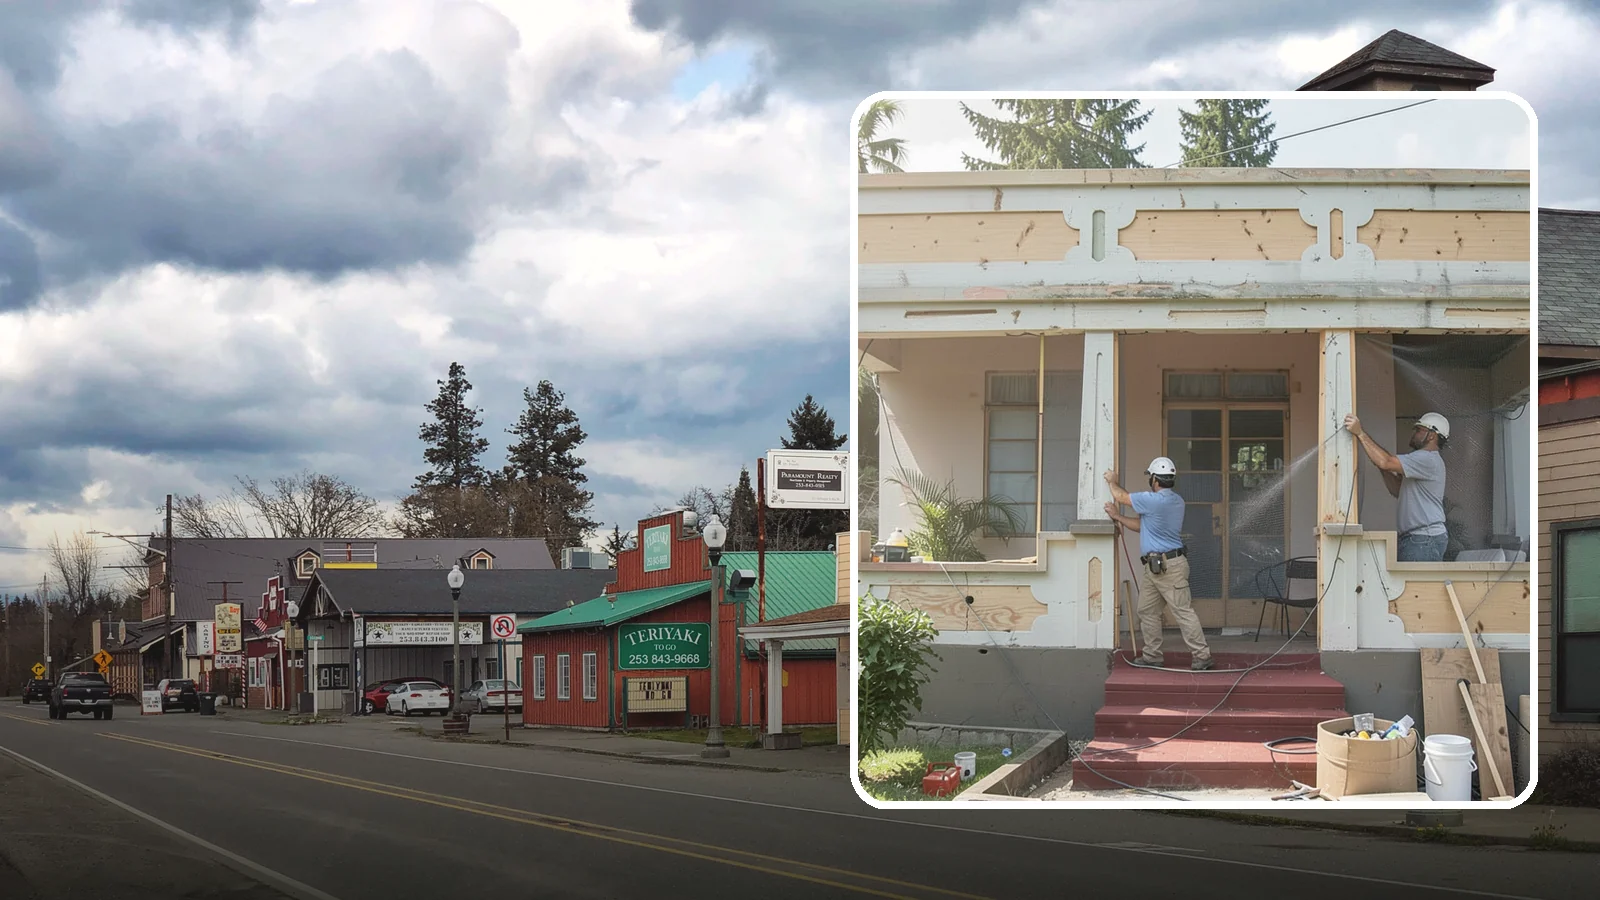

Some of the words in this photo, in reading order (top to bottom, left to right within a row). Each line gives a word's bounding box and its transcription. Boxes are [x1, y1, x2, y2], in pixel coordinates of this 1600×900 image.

[624, 628, 702, 646] TERIYAKI
[629, 654, 648, 664] 253
[652, 654, 700, 664] 843-9668
